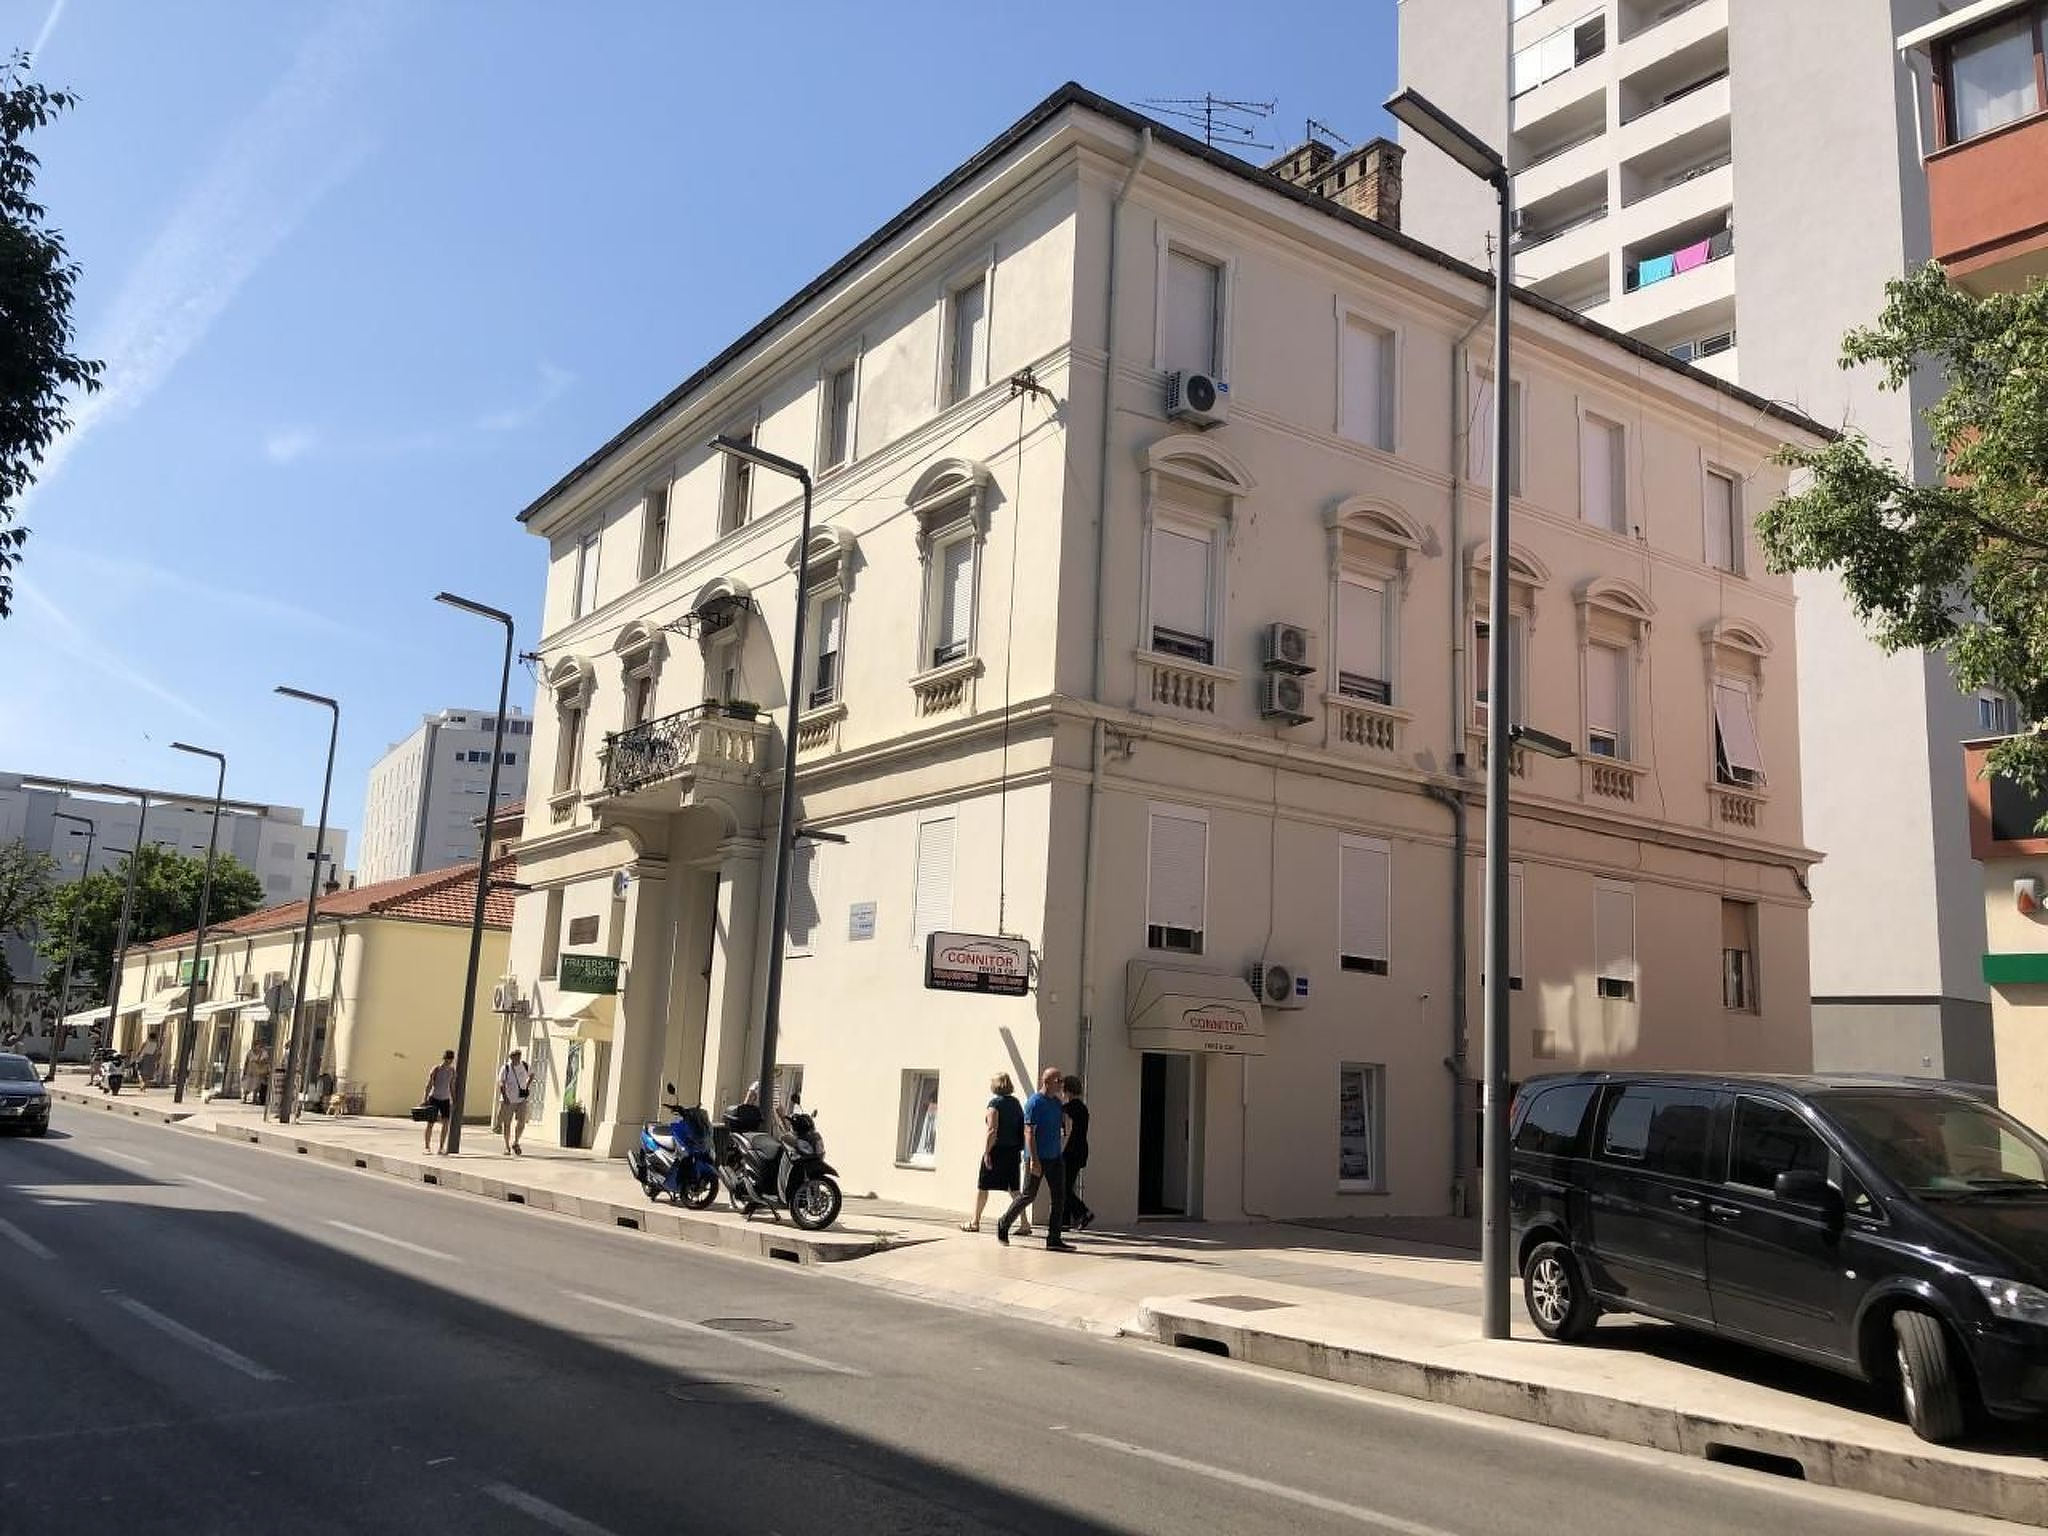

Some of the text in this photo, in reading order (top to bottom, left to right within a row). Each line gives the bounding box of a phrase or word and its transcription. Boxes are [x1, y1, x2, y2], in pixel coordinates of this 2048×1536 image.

[948, 952, 1014, 967] CONNITOR
[979, 965, 995, 974] rent
[1190, 1017, 1244, 1031] CONNITOR
